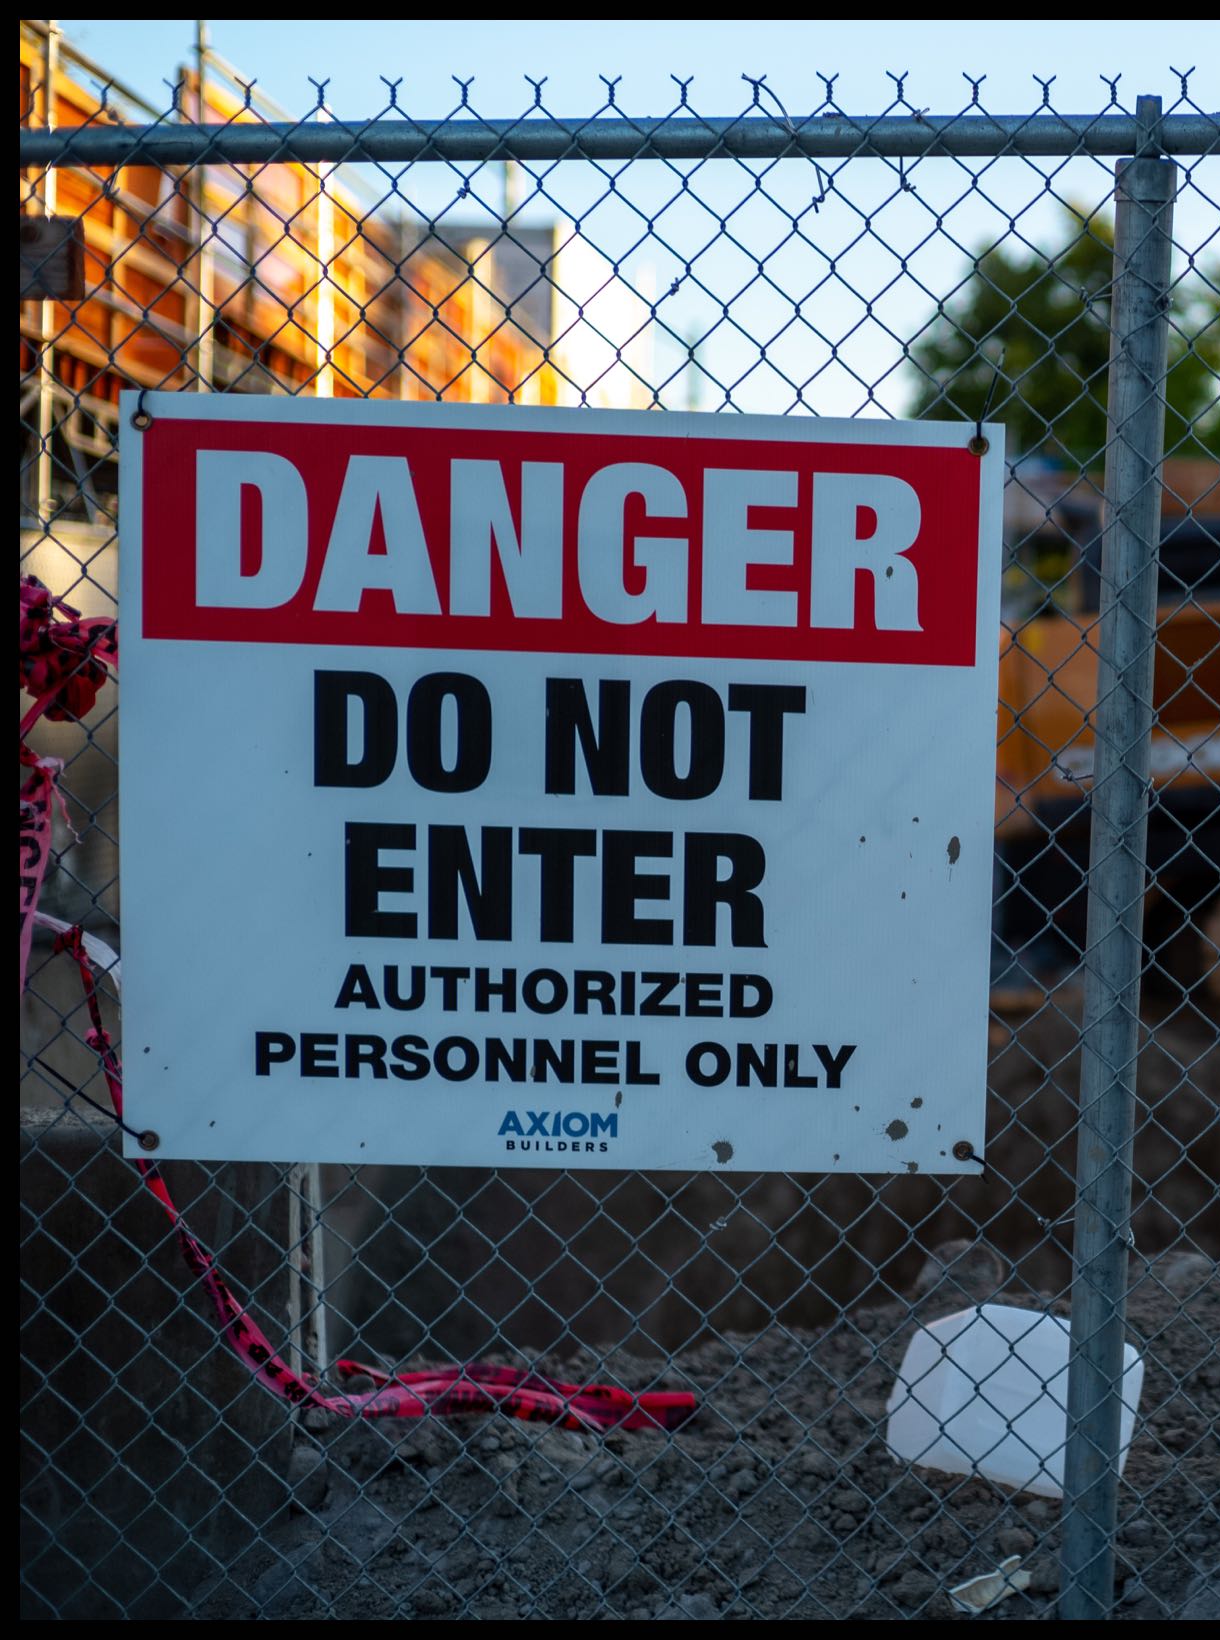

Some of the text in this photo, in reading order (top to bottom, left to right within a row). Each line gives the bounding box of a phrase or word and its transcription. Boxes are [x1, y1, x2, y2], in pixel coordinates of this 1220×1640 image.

[195, 448, 924, 632] DANGER
[313, 669, 807, 802] DO NOT
[344, 821, 769, 949] ENTER
[334, 964, 774, 1019] AUTHORIZED
[255, 1031, 857, 1090] PERSONNEL ONLY
[497, 1110, 618, 1138] AXIOM
[506, 1140, 608, 1153] BUILDERS
